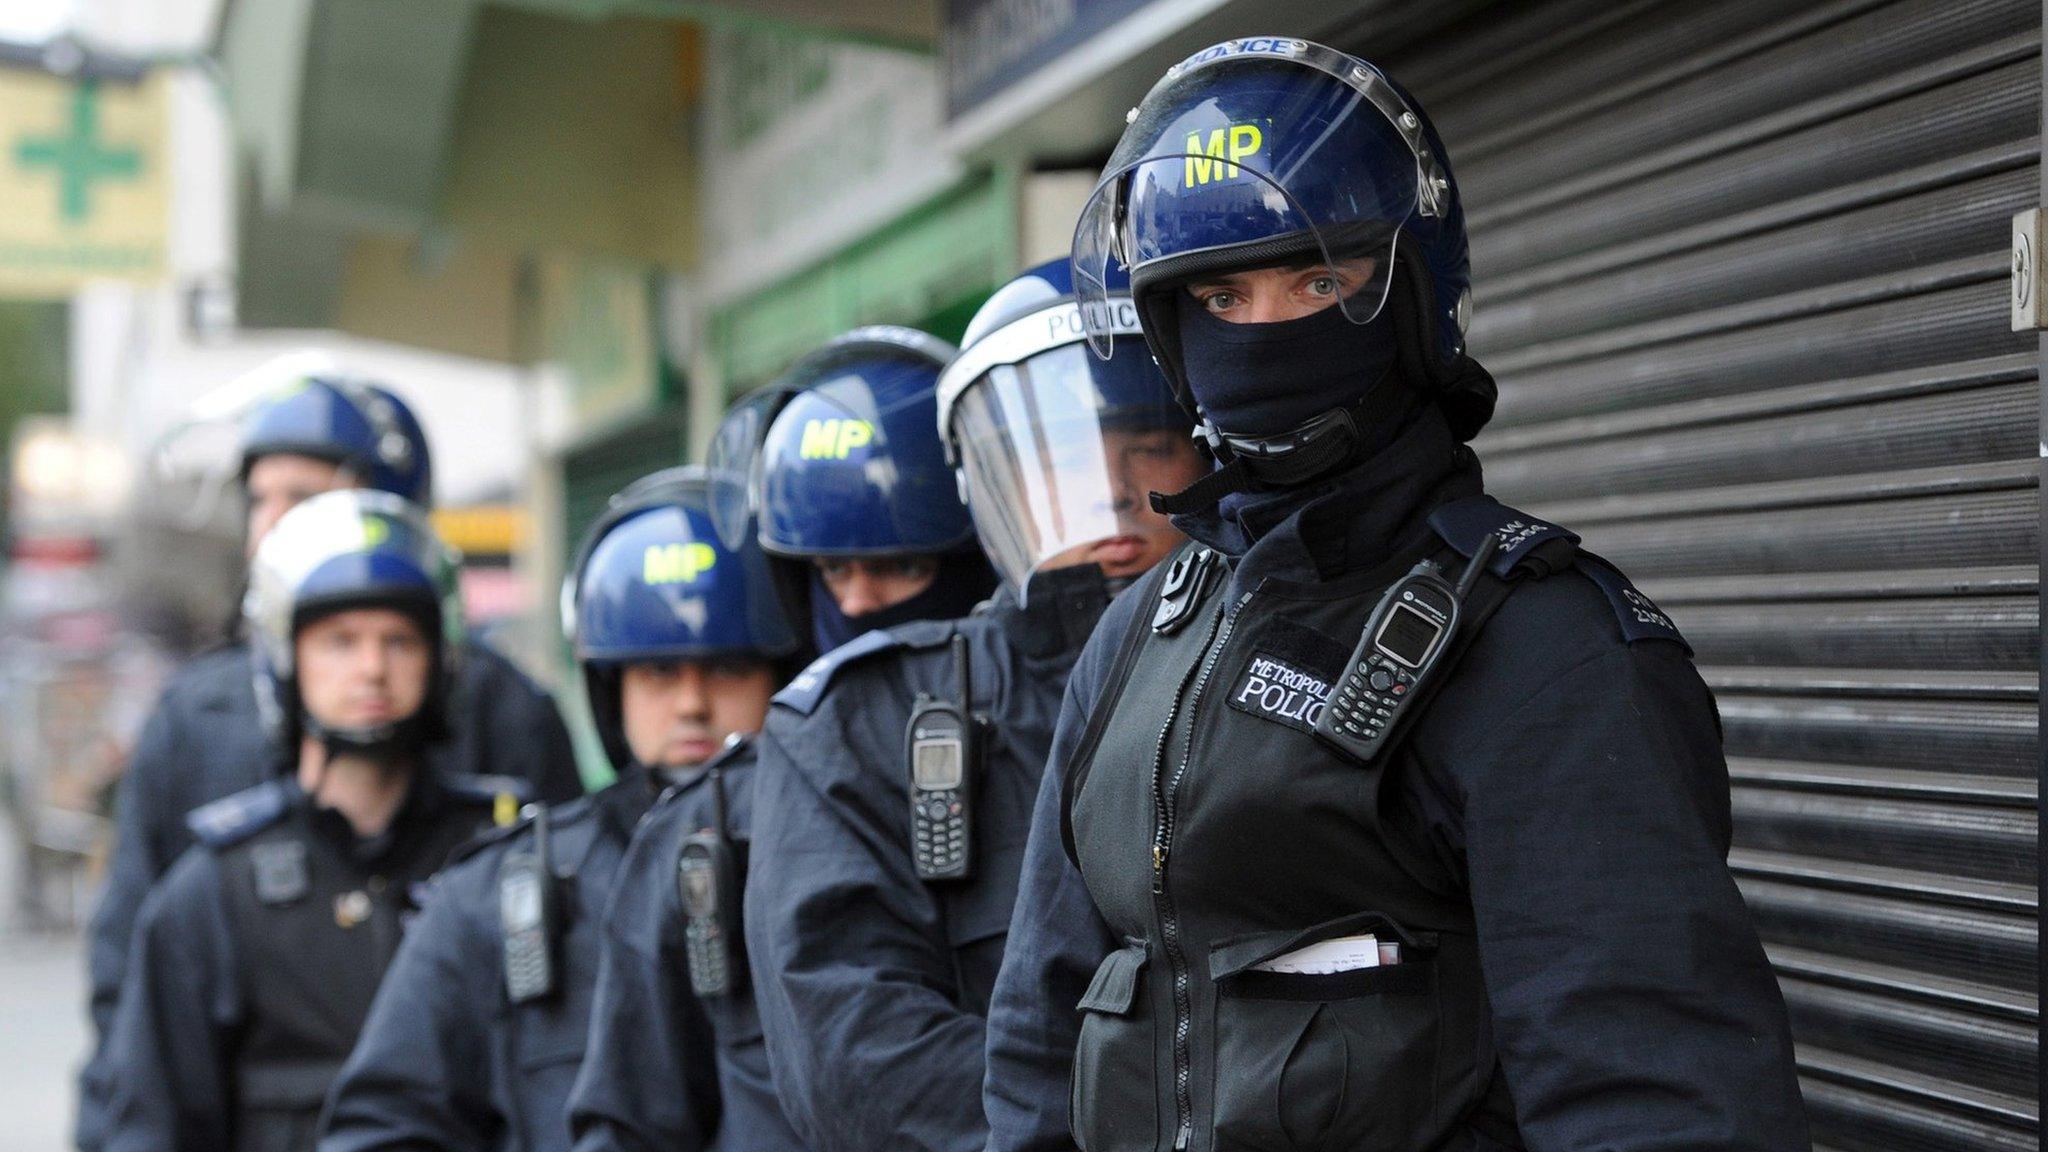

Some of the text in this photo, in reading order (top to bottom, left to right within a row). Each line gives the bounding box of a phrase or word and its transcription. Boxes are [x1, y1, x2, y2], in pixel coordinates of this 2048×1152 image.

[1181, 39, 1292, 70] POICE
[1185, 125, 1263, 189] MP
[800, 418, 875, 460] MP
[643, 542, 716, 586] MP
